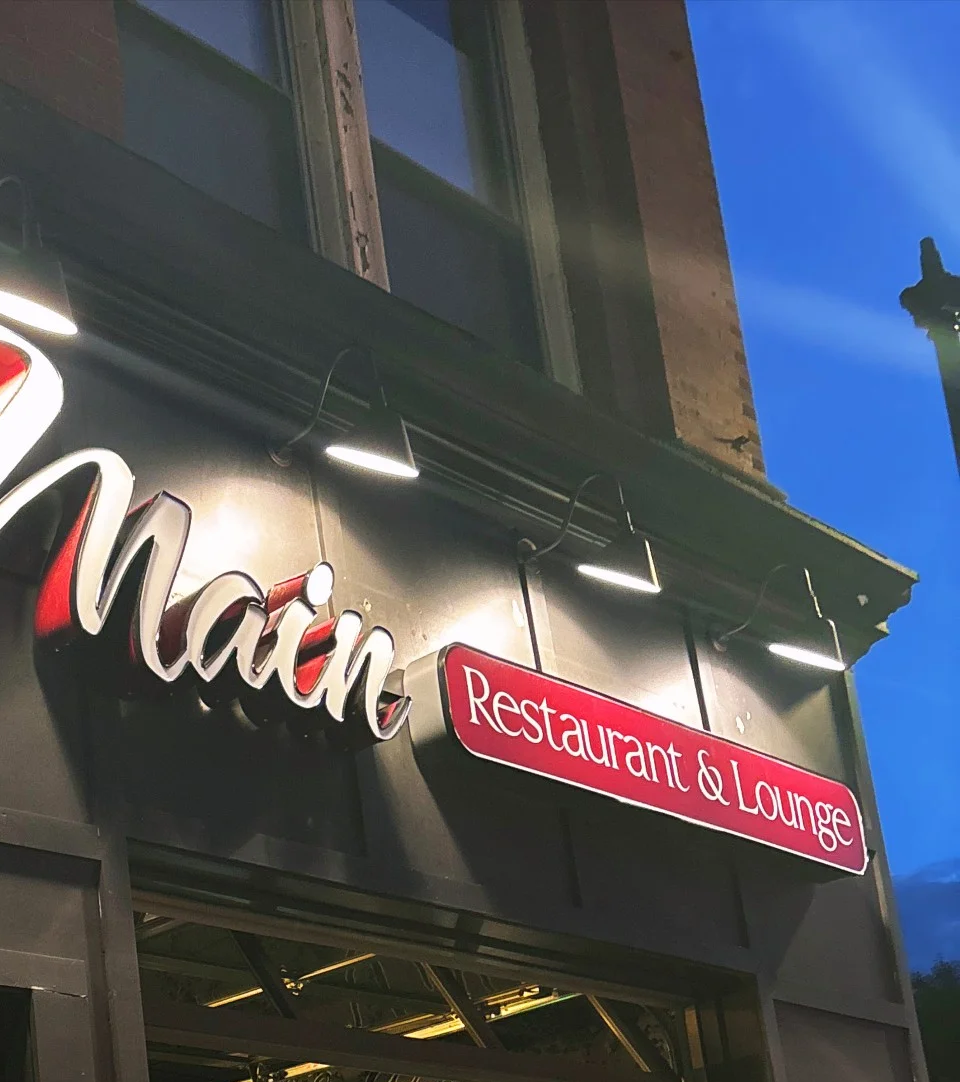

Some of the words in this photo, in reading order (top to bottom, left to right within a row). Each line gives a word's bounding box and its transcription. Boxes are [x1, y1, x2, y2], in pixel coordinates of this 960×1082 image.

[462, 665, 690, 792] Restaurant
[697, 749, 730, 806] &
[730, 759, 853, 852] Lounge
